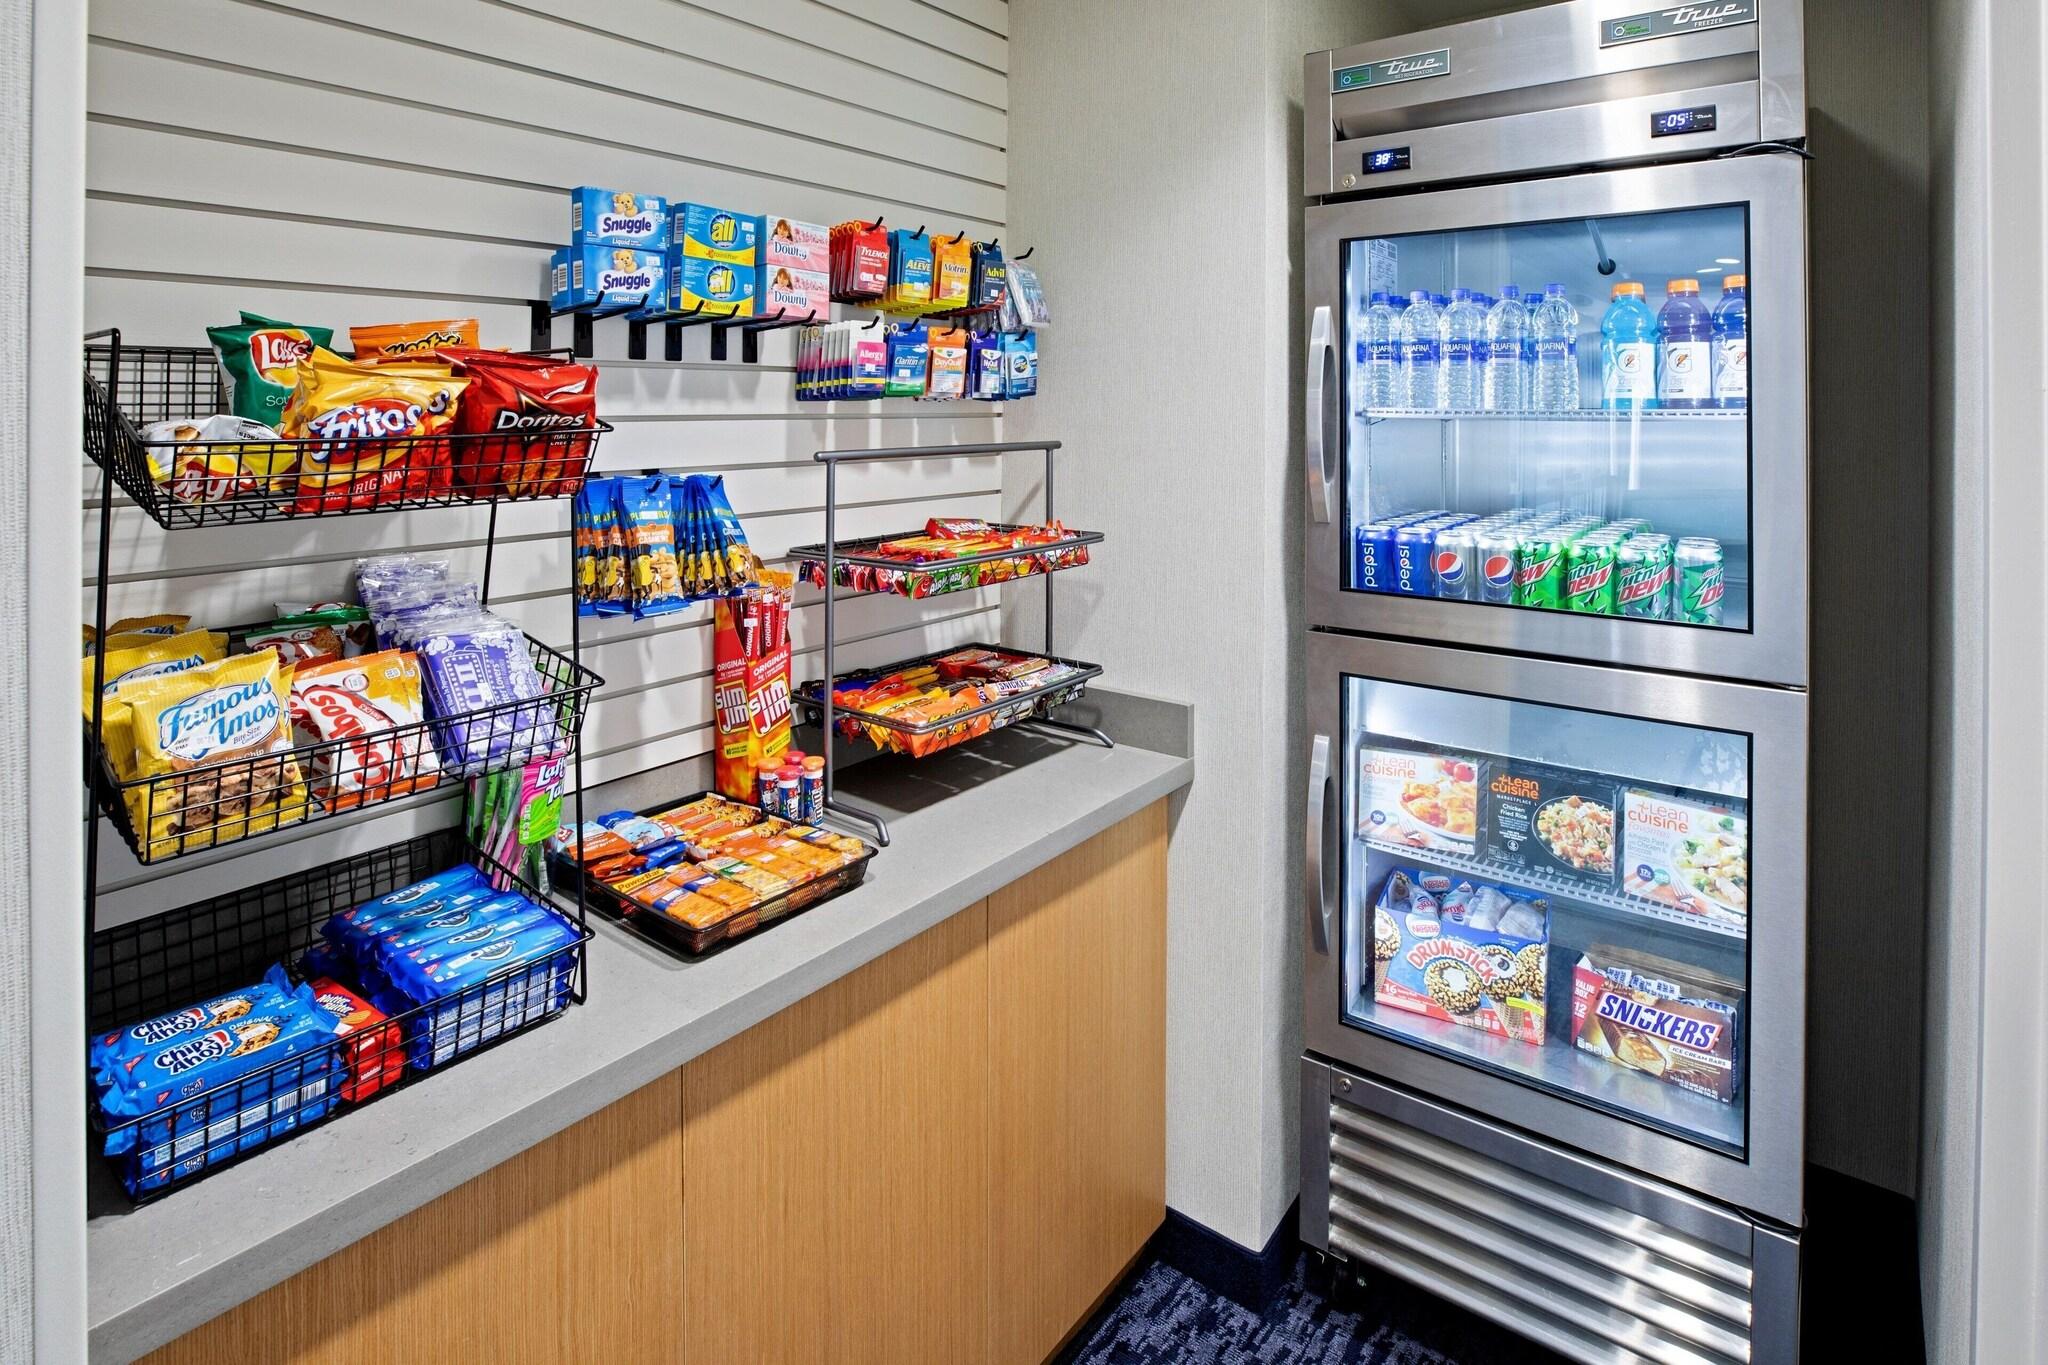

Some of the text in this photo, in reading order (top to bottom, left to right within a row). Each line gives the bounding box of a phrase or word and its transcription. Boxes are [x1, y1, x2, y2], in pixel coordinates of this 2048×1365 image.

[1694, 17, 1723, 28] FREEZER
[602, 216, 652, 234] Snuggle
[711, 218, 736, 242] all
[612, 238, 630, 246] Liquid
[906, 259, 932, 272] ALEVE
[986, 267, 1005, 278] Advil
[602, 272, 651, 290] Snuggle
[612, 294, 630, 302] Liquid
[774, 291, 807, 308] Downy
[859, 349, 884, 361] Allergy
[895, 356, 918, 366] Claritin
[496, 410, 586, 430] Doritos
[307, 404, 423, 463] Fritos
[1362, 543, 1378, 587] pepsi
[1398, 545, 1413, 591] pepsi
[764, 611, 772, 647] ORIGINAL
[717, 657, 747, 672] ORIGINAL
[753, 650, 789, 676] ORIGINAL
[157, 676, 272, 750] Famous
[191, 700, 281, 760] Amos
[232, 725, 261, 745] Bite Size
[1363, 763, 1416, 779] cuisine
[1382, 756, 1416, 769] Lean
[1491, 782, 1539, 799] cuisine
[1507, 776, 1538, 790] Lean
[1496, 794, 1532, 806] MARKETPLACE
[1502, 803, 1526, 813] Chicken
[1500, 809, 1528, 820] Fried Rice
[1628, 809, 1689, 834] cuisine
[1649, 803, 1689, 823] Lean
[617, 870, 660, 890] PowerBar
[448, 923, 497, 944] OREO
[469, 937, 517, 960] OREO
[1408, 938, 1499, 985] DRUMSTICK
[1384, 984, 1397, 994] 16
[1575, 979, 1595, 993] VALUE
[1575, 988, 1587, 999] BOX
[204, 994, 247, 1009] ORIGINAL
[316, 993, 351, 1004] Nutter
[1574, 1001, 1587, 1012] 12
[324, 1003, 354, 1015] Butter
[131, 1010, 190, 1039] Chips
[228, 1015, 274, 1031] ORIGINAL
[1601, 994, 1715, 1048] SNICKERS
[156, 1033, 214, 1069] Chips
[1672, 1047, 1726, 1067] ICE CREAM BARS
